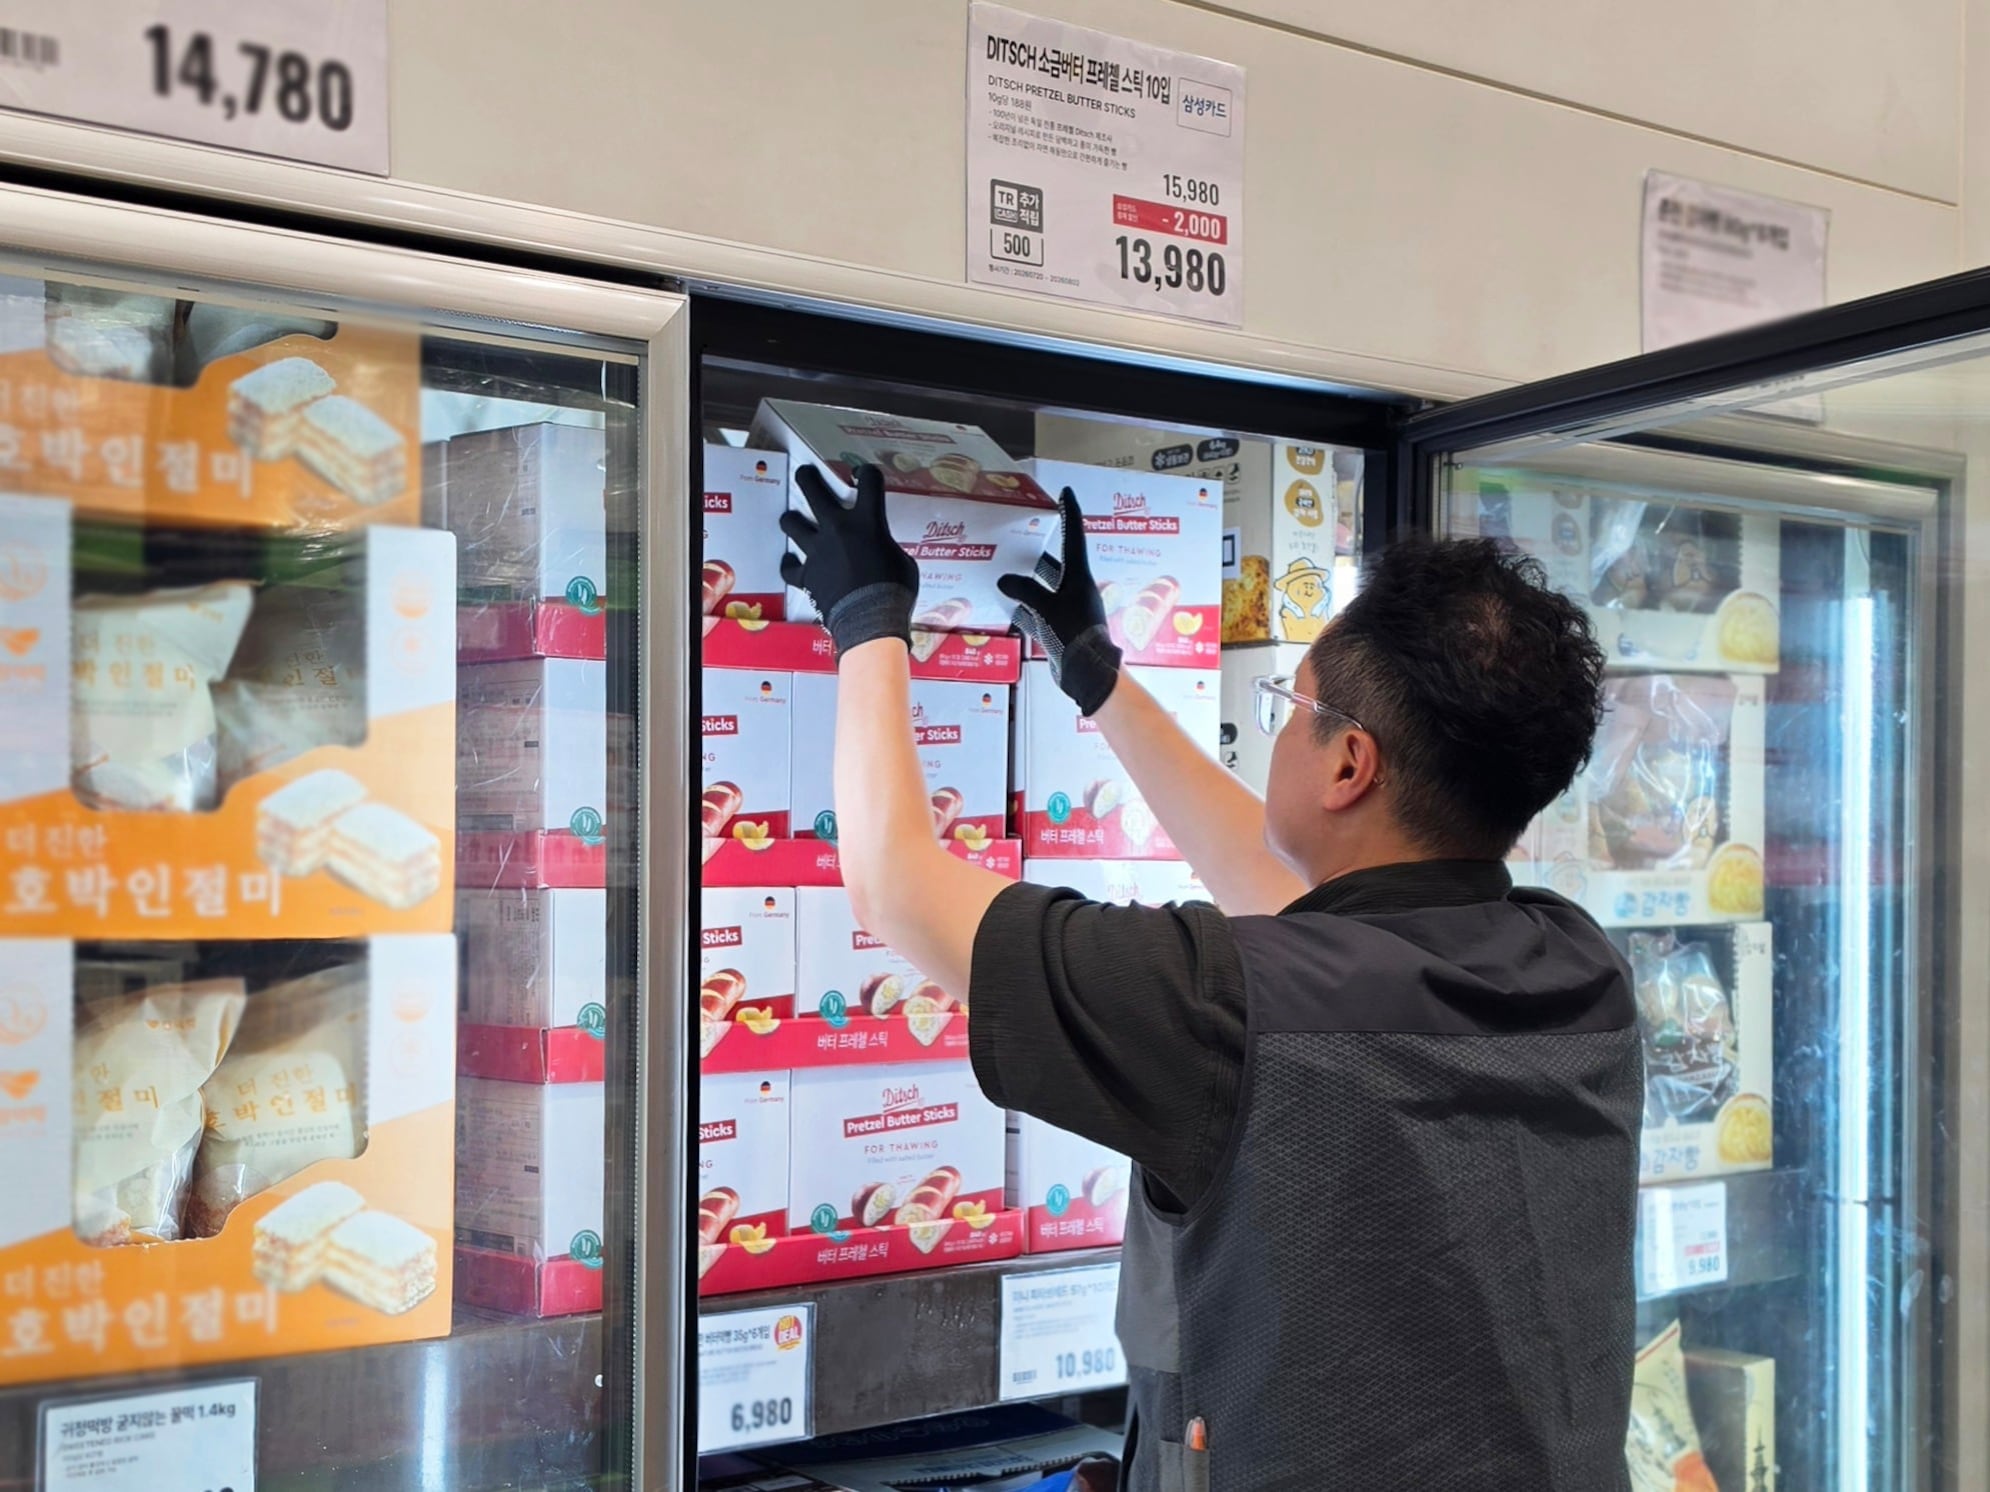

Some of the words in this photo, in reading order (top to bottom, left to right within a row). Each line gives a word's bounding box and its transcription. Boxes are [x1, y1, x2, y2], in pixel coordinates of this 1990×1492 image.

[146, 23, 353, 132] 14,780
[987, 35, 1037, 71] DITSCH
[1038, 47, 1084, 85] 소금버터
[1086, 58, 1120, 93] 프레첼
[1121, 67, 1144, 99] 스틱
[1146, 74, 1171, 105] 10입
[988, 75, 1024, 92] DITSCH
[1025, 83, 1065, 103] PRETZEL
[1067, 93, 1102, 110] BUTTER
[1104, 102, 1136, 119] STICKS
[1182, 94, 1228, 118] 삼성카드
[997, 190, 1014, 206] TR
[1020, 191, 1040, 210] 추가
[1163, 174, 1219, 206] 15,980
[1020, 208, 1040, 227] 적립
[1174, 211, 1221, 240] 2,000
[1003, 232, 1030, 257] 500
[1116, 235, 1226, 297] 13,980
[923, 520, 966, 540] Ditsch
[1116, 518, 1148, 531] Butter
[1149, 519, 1178, 531] Sticks
[921, 545, 957, 557] Butter
[957, 545, 991, 558] Sticks
[926, 727, 959, 741] Sticks
[6, 862, 285, 920] 호박인절미
[702, 928, 739, 945] Sticks
[817, 1033, 837, 1050] 버터
[868, 1030, 889, 1048] 스틱
[882, 1084, 920, 1108] Ditsch
[846, 1116, 885, 1134] Pretzel
[886, 1112, 922, 1128] Butter
[923, 1106, 955, 1122] Sticks
[864, 1145, 885, 1155] FOR
[889, 1140, 938, 1153] THAWING
[1040, 1222, 1058, 1238] 버터
[1085, 1216, 1105, 1234] 스틱
[817, 1247, 837, 1266] 버터
[868, 1241, 889, 1259] 스틱
[44, 1259, 107, 1299] 진한
[3, 1282, 279, 1356] 호박인절미
[1056, 1346, 1115, 1380] 10,980
[197, 1402, 236, 1419] 1.4kg
[731, 1397, 792, 1434] 6,980
